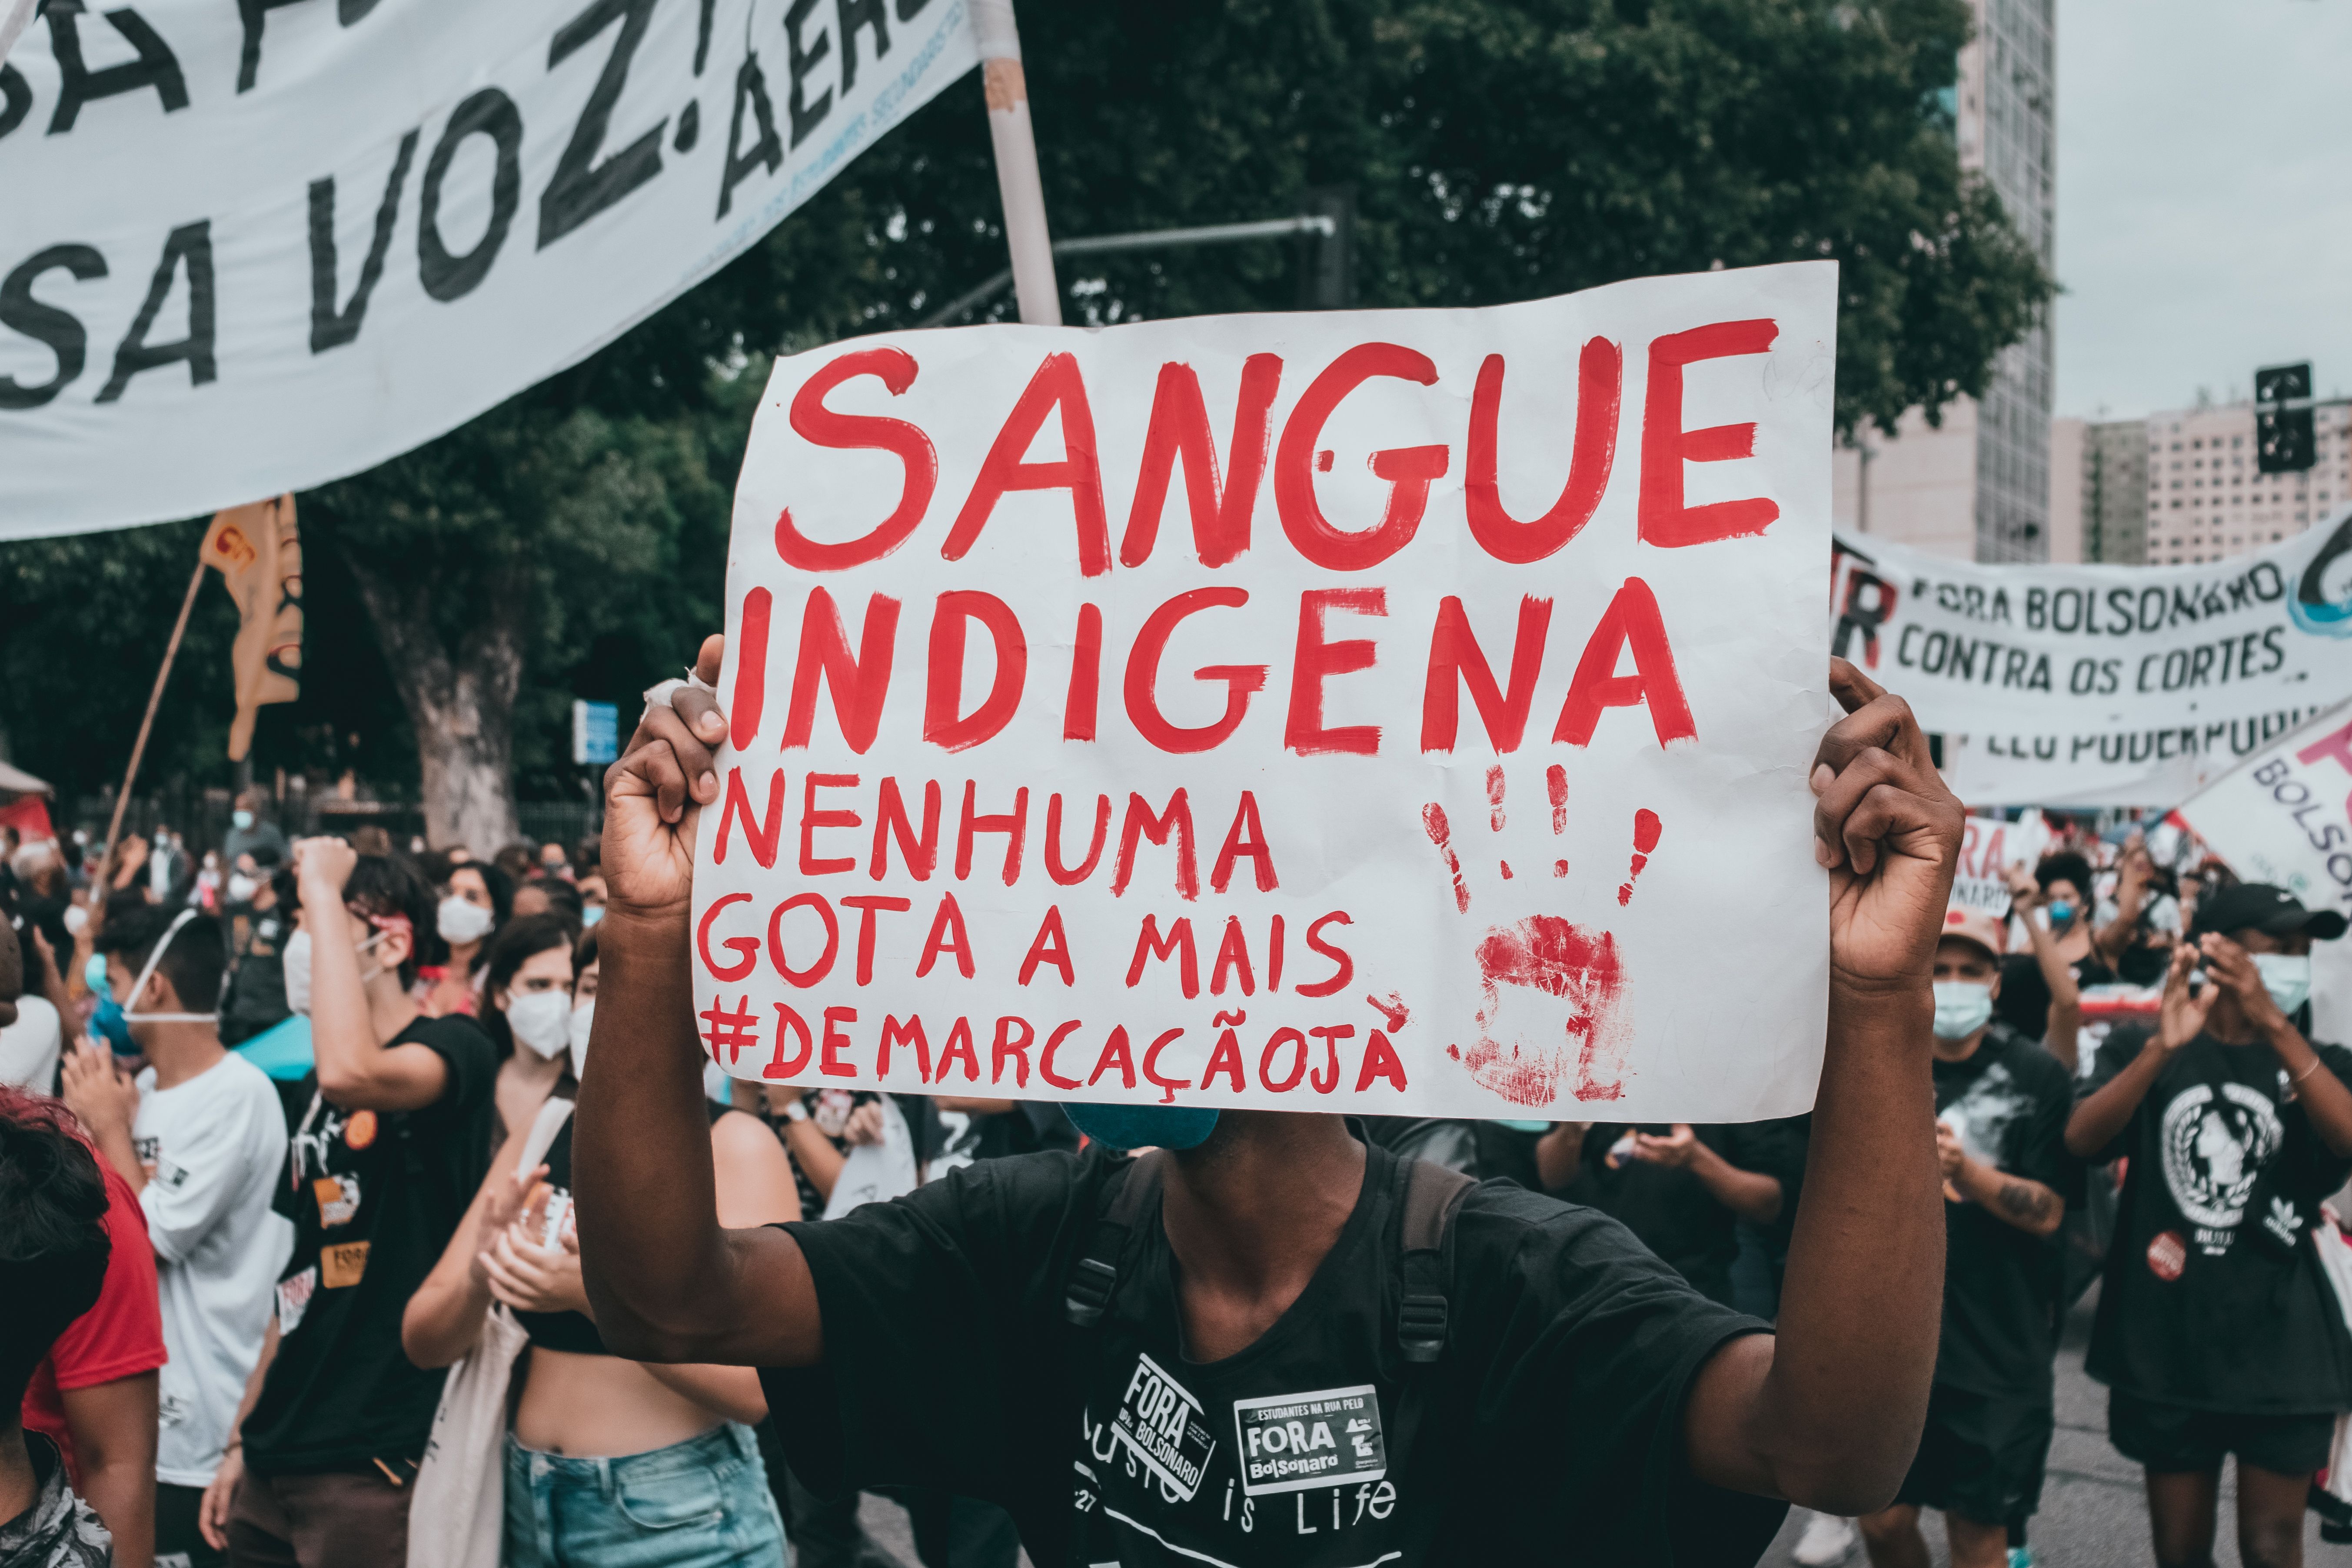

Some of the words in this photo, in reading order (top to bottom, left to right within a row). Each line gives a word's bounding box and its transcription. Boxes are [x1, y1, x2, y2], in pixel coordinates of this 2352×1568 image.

[775, 319, 1780, 578] SANGUE
[730, 576, 1698, 757] INDIGENA
[1897, 623, 2053, 693] CONTRA
[2069, 657, 2123, 696] OS
[713, 765, 1279, 902] NENHUMA
[697, 892, 976, 989] GOTA
[1018, 905, 1075, 987] A
[1125, 910, 1354, 1000] MAIS
[1123, 1362, 1190, 1449] FORA
[1247, 1420, 1337, 1457] FORA
[1258, 1405, 1309, 1421] ESTUDANTES
[1310, 1402, 1324, 1415] NA
[1325, 1398, 1341, 1412] RUA
[1342, 1397, 1364, 1409] PELO
[1135, 1420, 1199, 1486] BOLSONARO
[1250, 1454, 1339, 1479] Bolsonaro
[1223, 1478, 1255, 1533] is
[1297, 1481, 1397, 1535] Life
